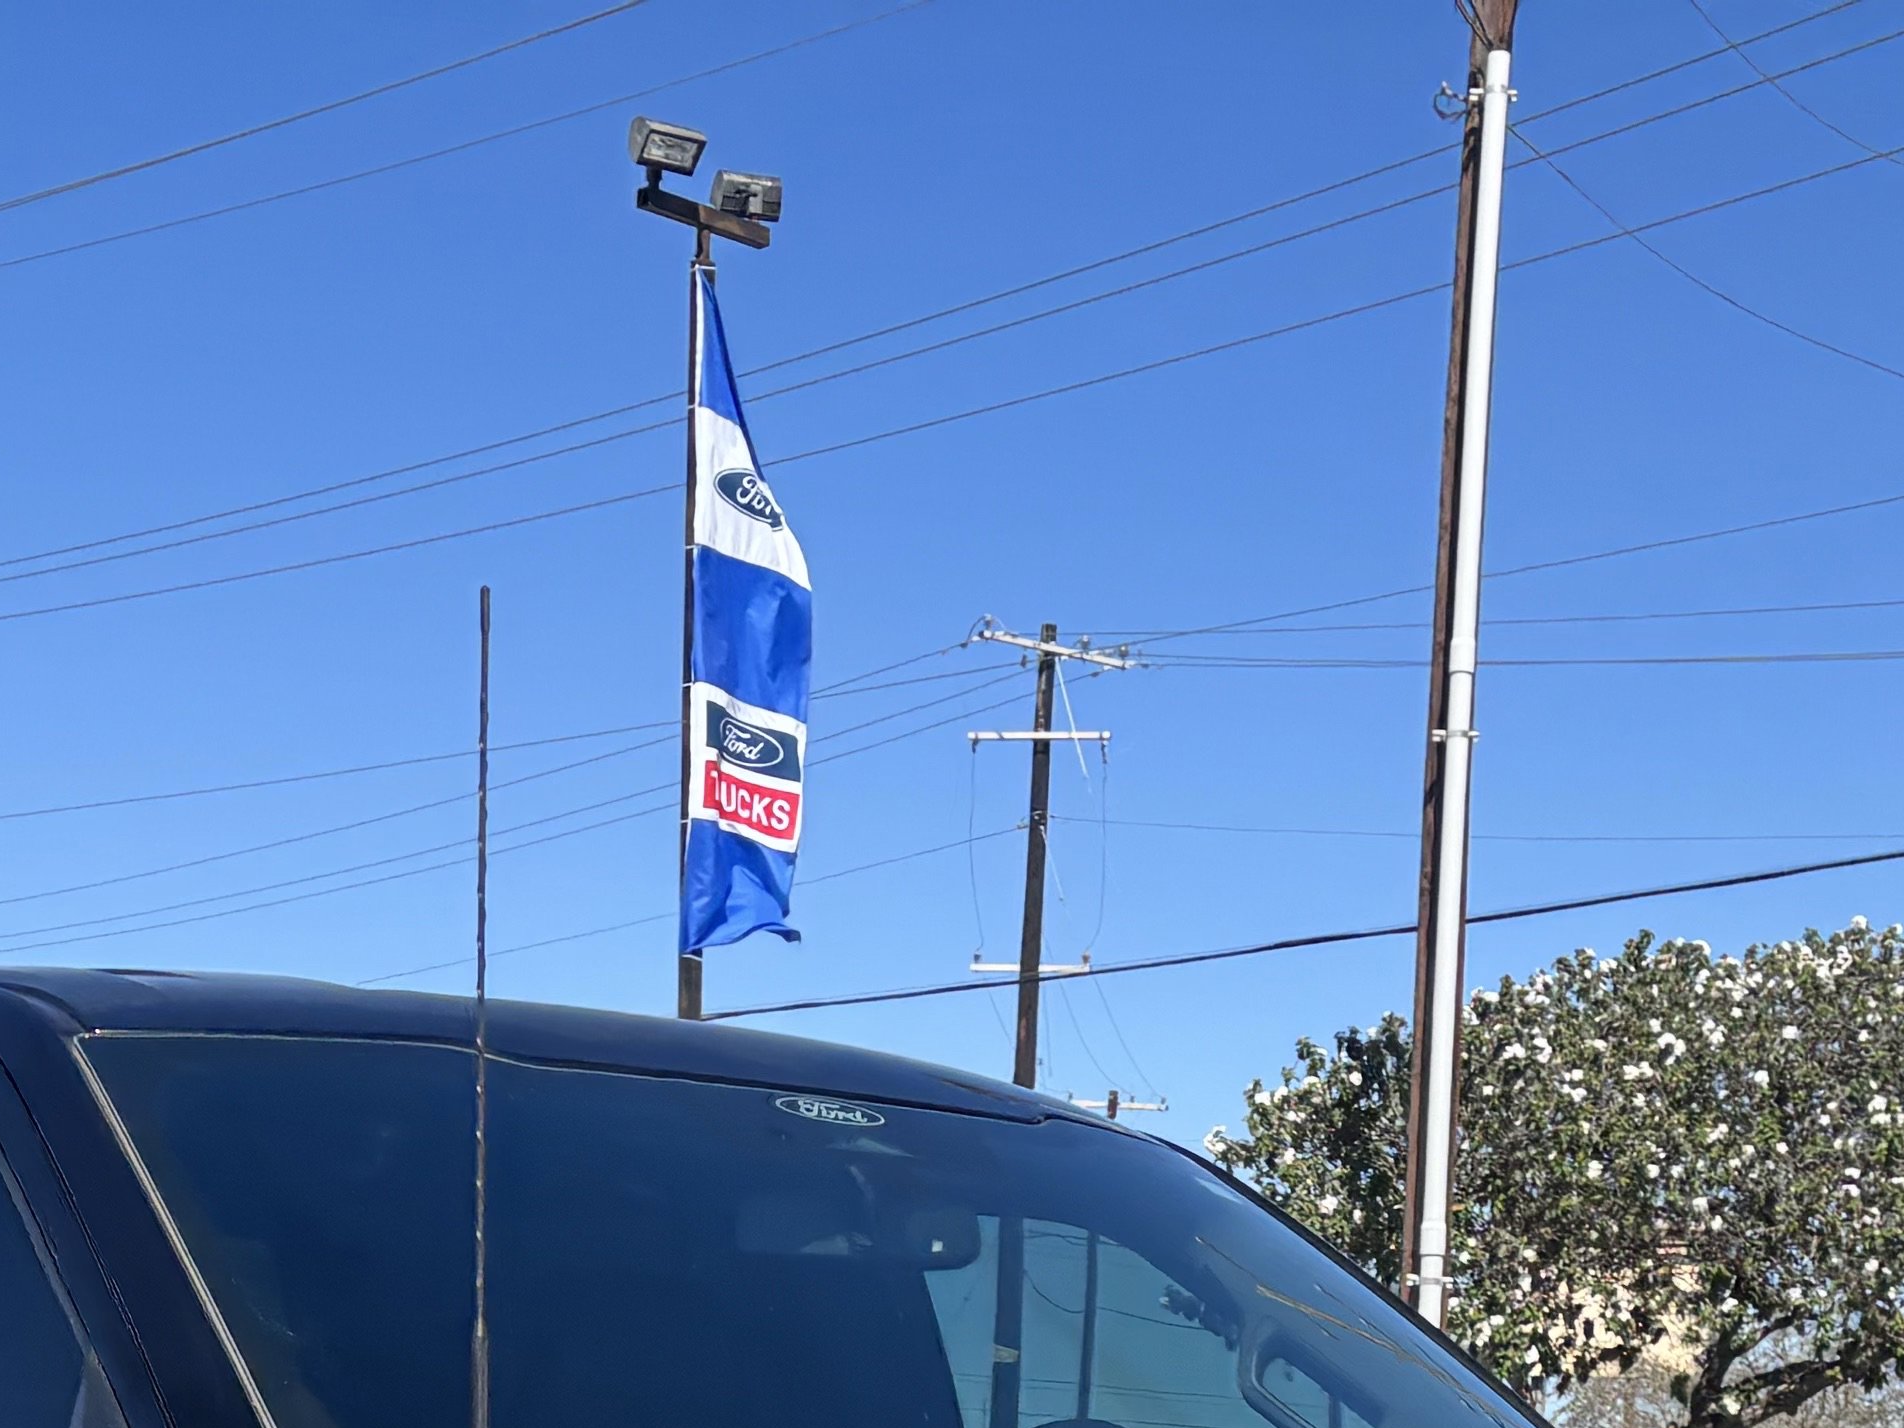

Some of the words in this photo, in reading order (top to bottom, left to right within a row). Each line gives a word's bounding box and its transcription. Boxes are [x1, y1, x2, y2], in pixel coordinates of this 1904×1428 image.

[723, 724, 764, 760] Ford
[709, 770, 791, 831] TUCKS
[798, 1100, 868, 1123] Ford
